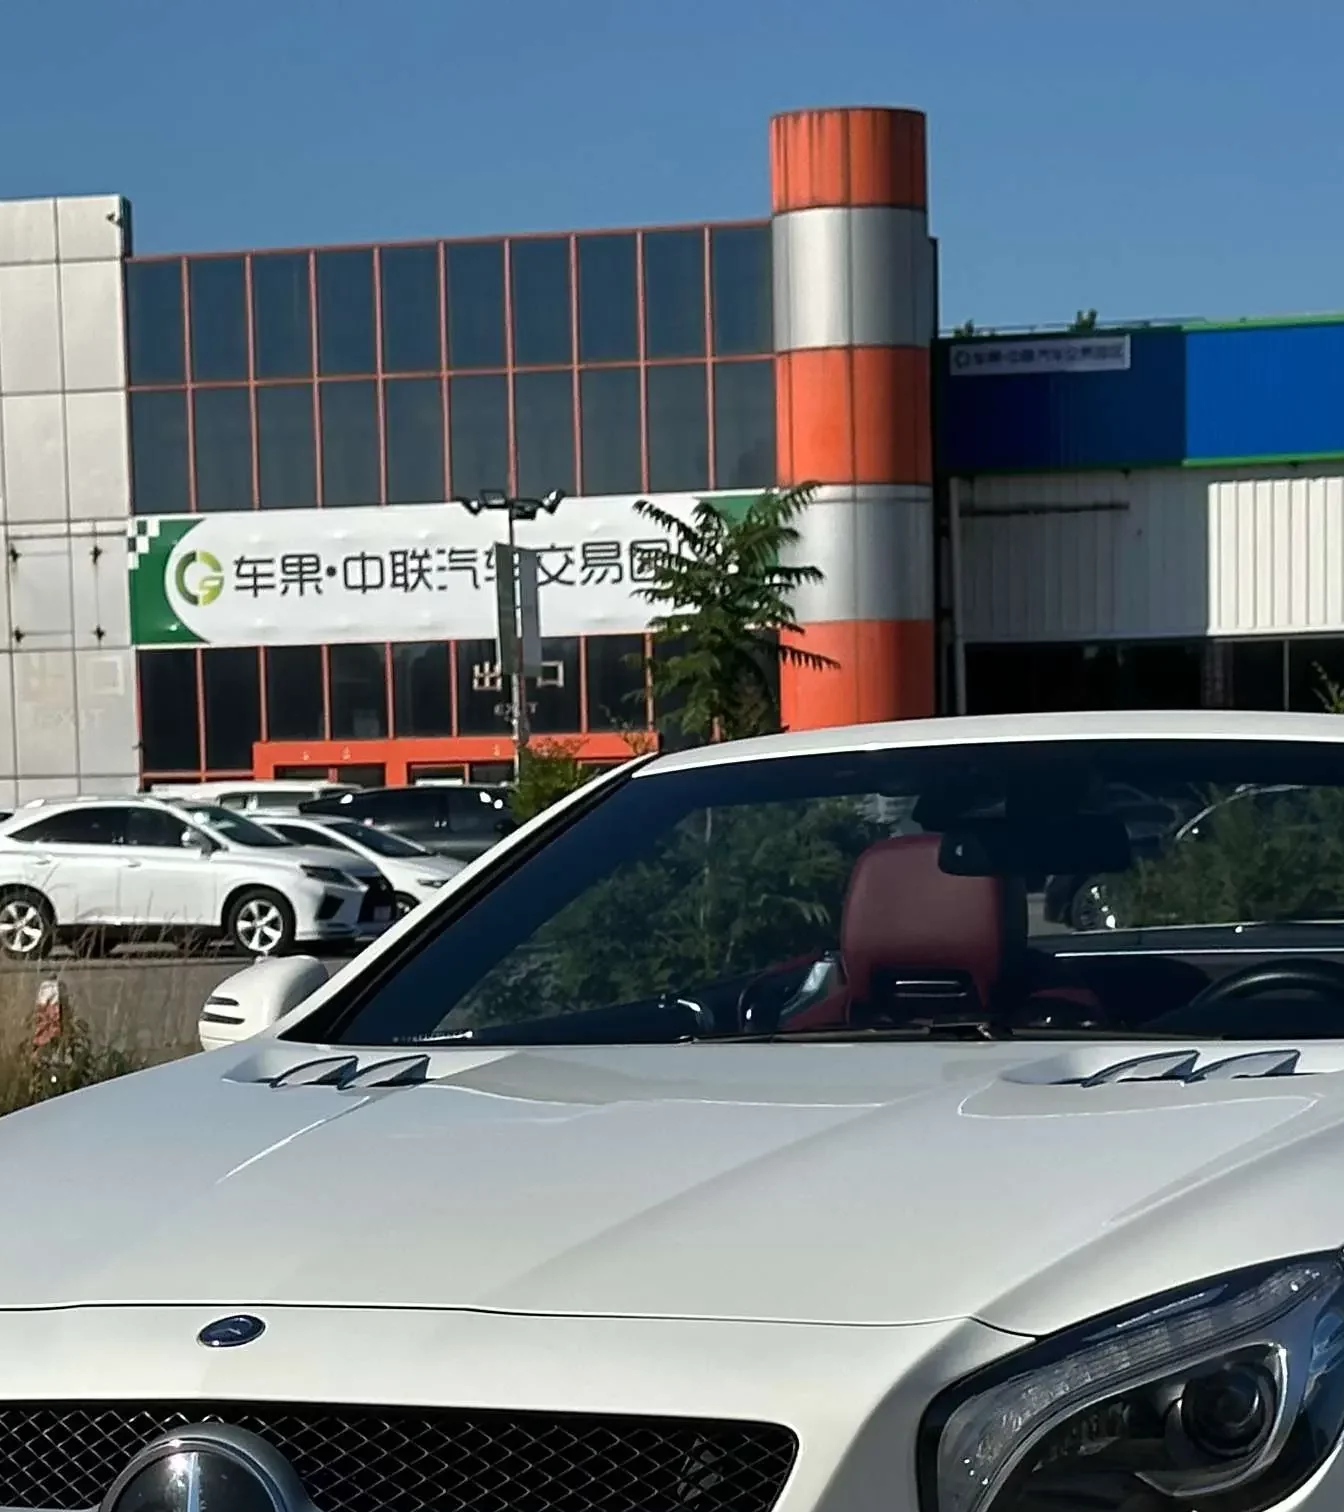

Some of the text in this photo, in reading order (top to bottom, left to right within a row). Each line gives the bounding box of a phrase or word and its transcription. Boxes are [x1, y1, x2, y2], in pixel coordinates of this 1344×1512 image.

[233, 538, 706, 600] 车果·中联汽交易园
[472, 660, 565, 692] 出口
